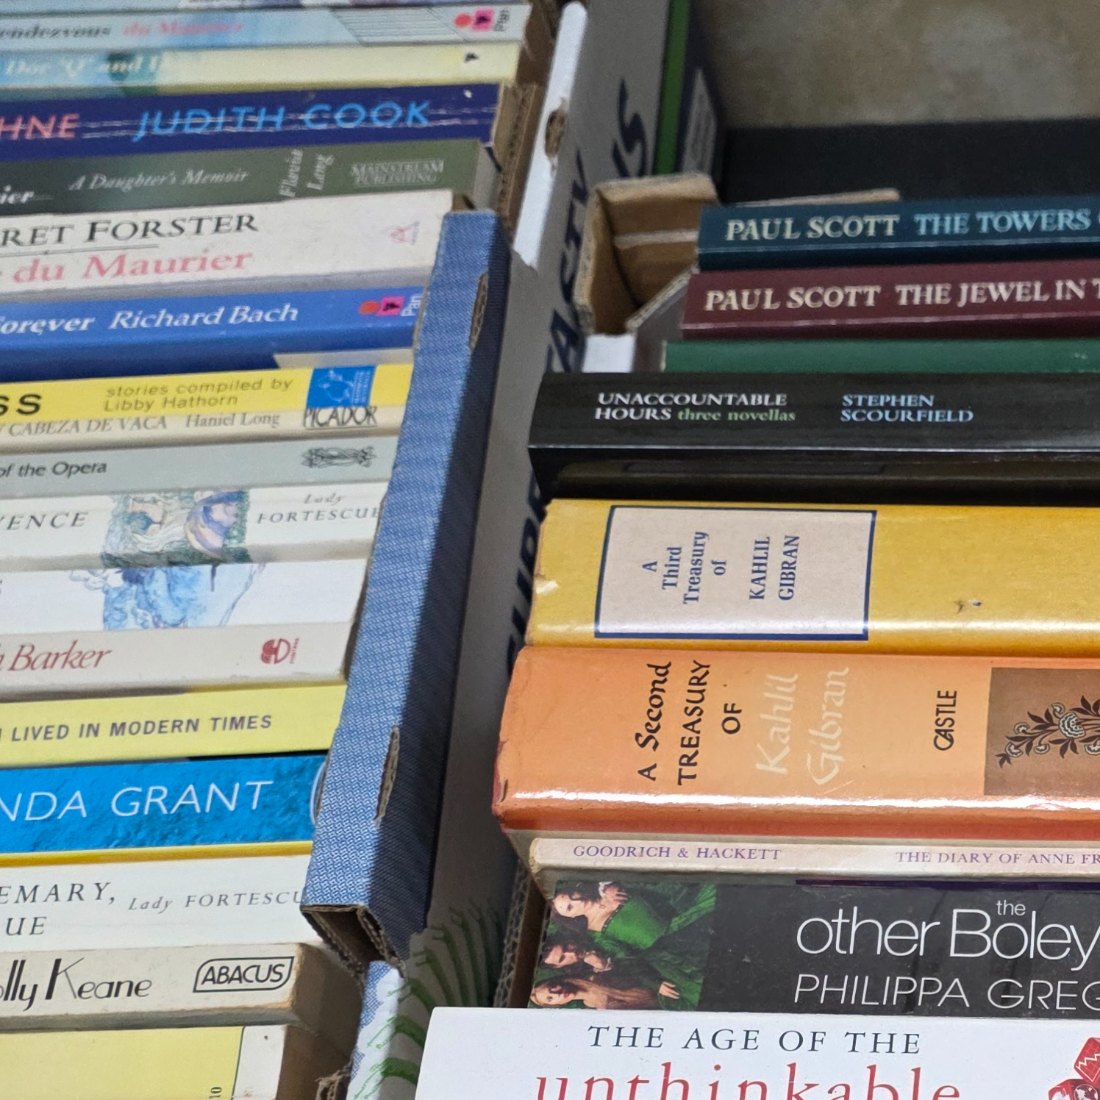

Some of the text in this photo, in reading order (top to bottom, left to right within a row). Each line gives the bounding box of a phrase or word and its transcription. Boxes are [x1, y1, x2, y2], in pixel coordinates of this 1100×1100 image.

[131, 101, 431, 142] JUDITH COOK
[89, 167, 249, 193] Daughter's Memoir
[84, 214, 259, 243] FORSTER
[725, 216, 800, 242] PAUL
[806, 214, 900, 239] SCOTT
[914, 212, 970, 236] THE
[975, 207, 1091, 233] TOWERS
[13, 248, 254, 284] du Maurier
[705, 289, 780, 312] PAUL
[786, 285, 881, 310] SCOTT
[895, 283, 952, 306] THE
[957, 279, 1050, 308] JEWEL
[1055, 279, 1086, 301] IN
[108, 303, 298, 330] Richard Bach
[105, 378, 294, 398] stories compiled by
[597, 392, 788, 407] UNACCOUNTABLE
[842, 394, 935, 408] STEPHEN
[104, 395, 239, 413] Libby Hathorn
[303, 406, 378, 428] PICADOR
[594, 406, 797, 423] HOURS three novellas
[840, 409, 975, 424] SCOURFIELD
[8, 419, 82, 437] CABEZA
[86, 419, 113, 433] DE
[185, 411, 237, 428] Haniel
[241, 411, 281, 429] Long
[18, 460, 108, 479] the Opera
[641, 560, 658, 573] A
[662, 545, 683, 590] Third
[683, 531, 710, 605] Treasury
[712, 559, 728, 576] of
[749, 536, 771, 600] KAHLIL
[778, 535, 800, 601] GIBRAN
[8, 640, 111, 671] Barker
[12, 714, 273, 741] LIVED IN MODERN TIMES
[634, 661, 672, 782] A Second
[677, 660, 711, 786] TREASURY
[721, 702, 743, 735] OF
[756, 673, 799, 775] Kahlil
[806, 666, 850, 786] Gibran
[933, 689, 959, 752] CASTLE
[111, 780, 274, 818] GRANT
[573, 844, 782, 861] GOODRICH & HACKETT
[895, 850, 931, 864] THE
[937, 851, 993, 865] DIARY
[998, 852, 1023, 865] OF
[1027, 852, 1077, 865] ANNE
[128, 897, 174, 912] Lady
[996, 898, 1027, 917] the
[5, 915, 48, 936] UE
[796, 905, 942, 956] other
[45, 957, 153, 1001] Keane
[200, 963, 287, 985] ABACUS
[794, 973, 970, 1008] PHILIPPA
[586, 1024, 921, 1055] THE AGE OF THE
